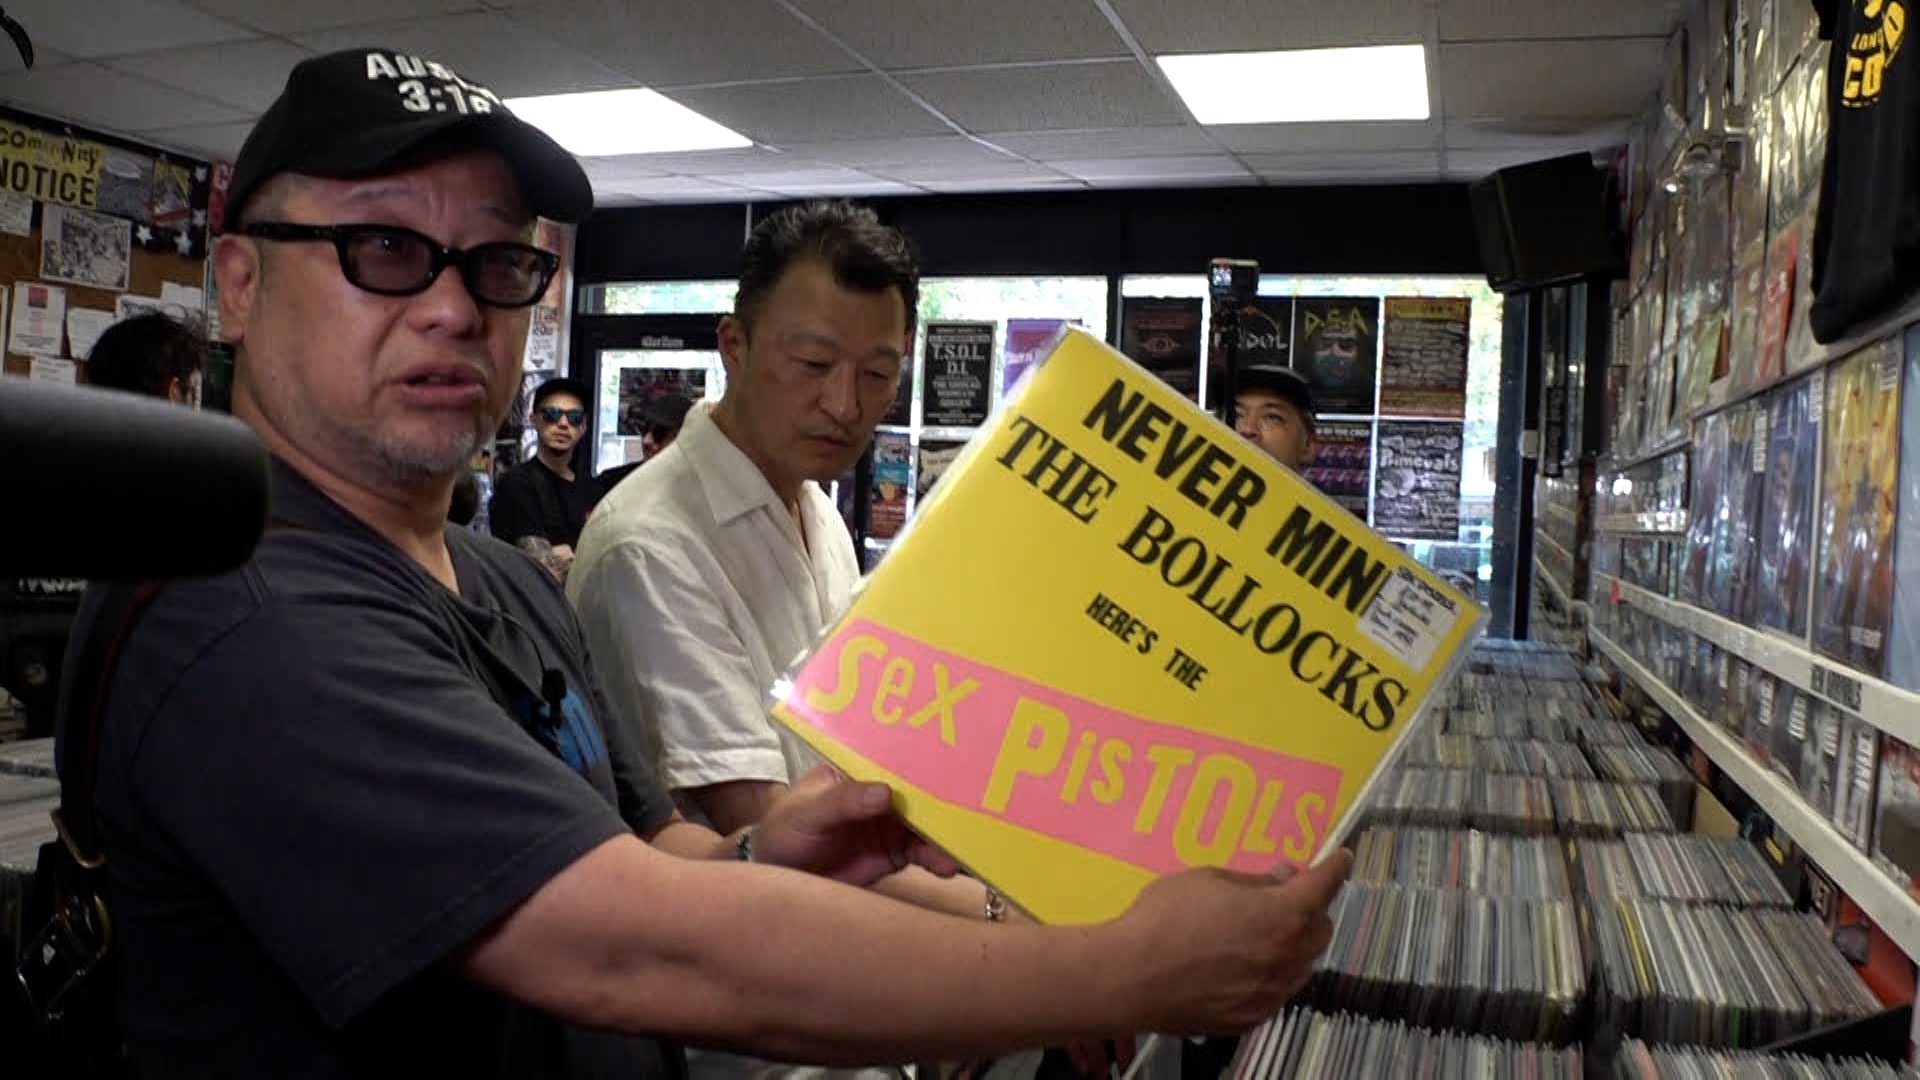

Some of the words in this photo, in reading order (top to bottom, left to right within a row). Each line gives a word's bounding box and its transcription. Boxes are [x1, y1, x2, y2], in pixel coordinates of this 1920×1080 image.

[996, 415, 1118, 525] THE
[1117, 505, 1409, 733] BOLLOCKS
[1082, 378, 1267, 530] NEVER
[1265, 502, 1393, 618] MIN
[1085, 593, 1159, 655] HERE'S
[1164, 647, 1209, 692] THE
